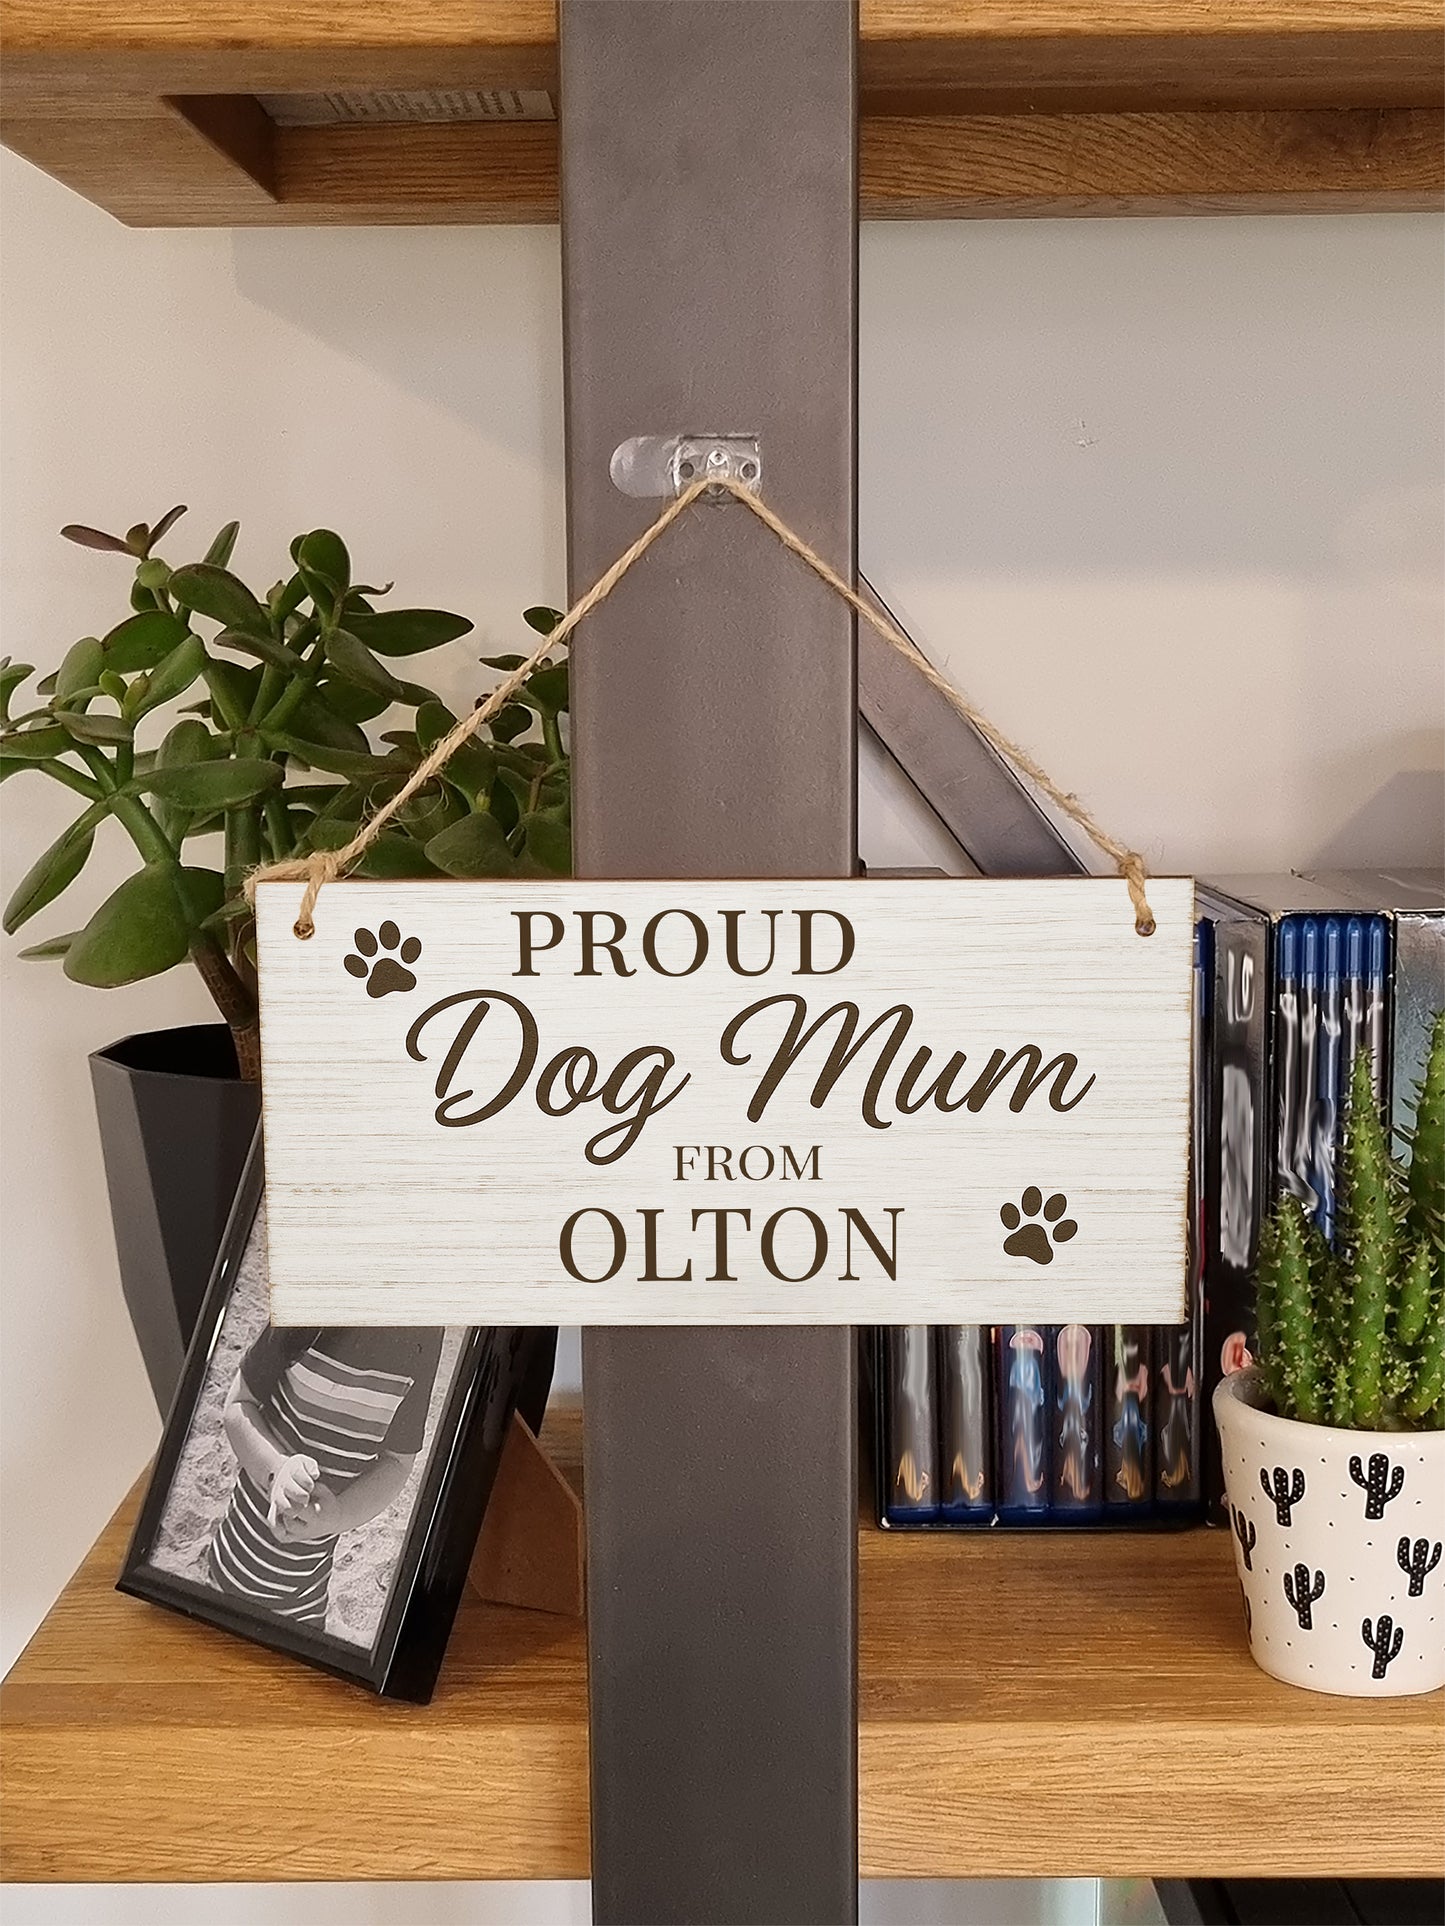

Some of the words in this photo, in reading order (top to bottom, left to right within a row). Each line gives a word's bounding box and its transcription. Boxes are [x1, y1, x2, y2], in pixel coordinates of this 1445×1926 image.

[511, 909, 856, 977] PROUD
[406, 990, 691, 1165] Dog
[720, 994, 1096, 1129] Mum
[673, 1146, 822, 1180] FROM
[560, 1207, 904, 1283] OLTON
